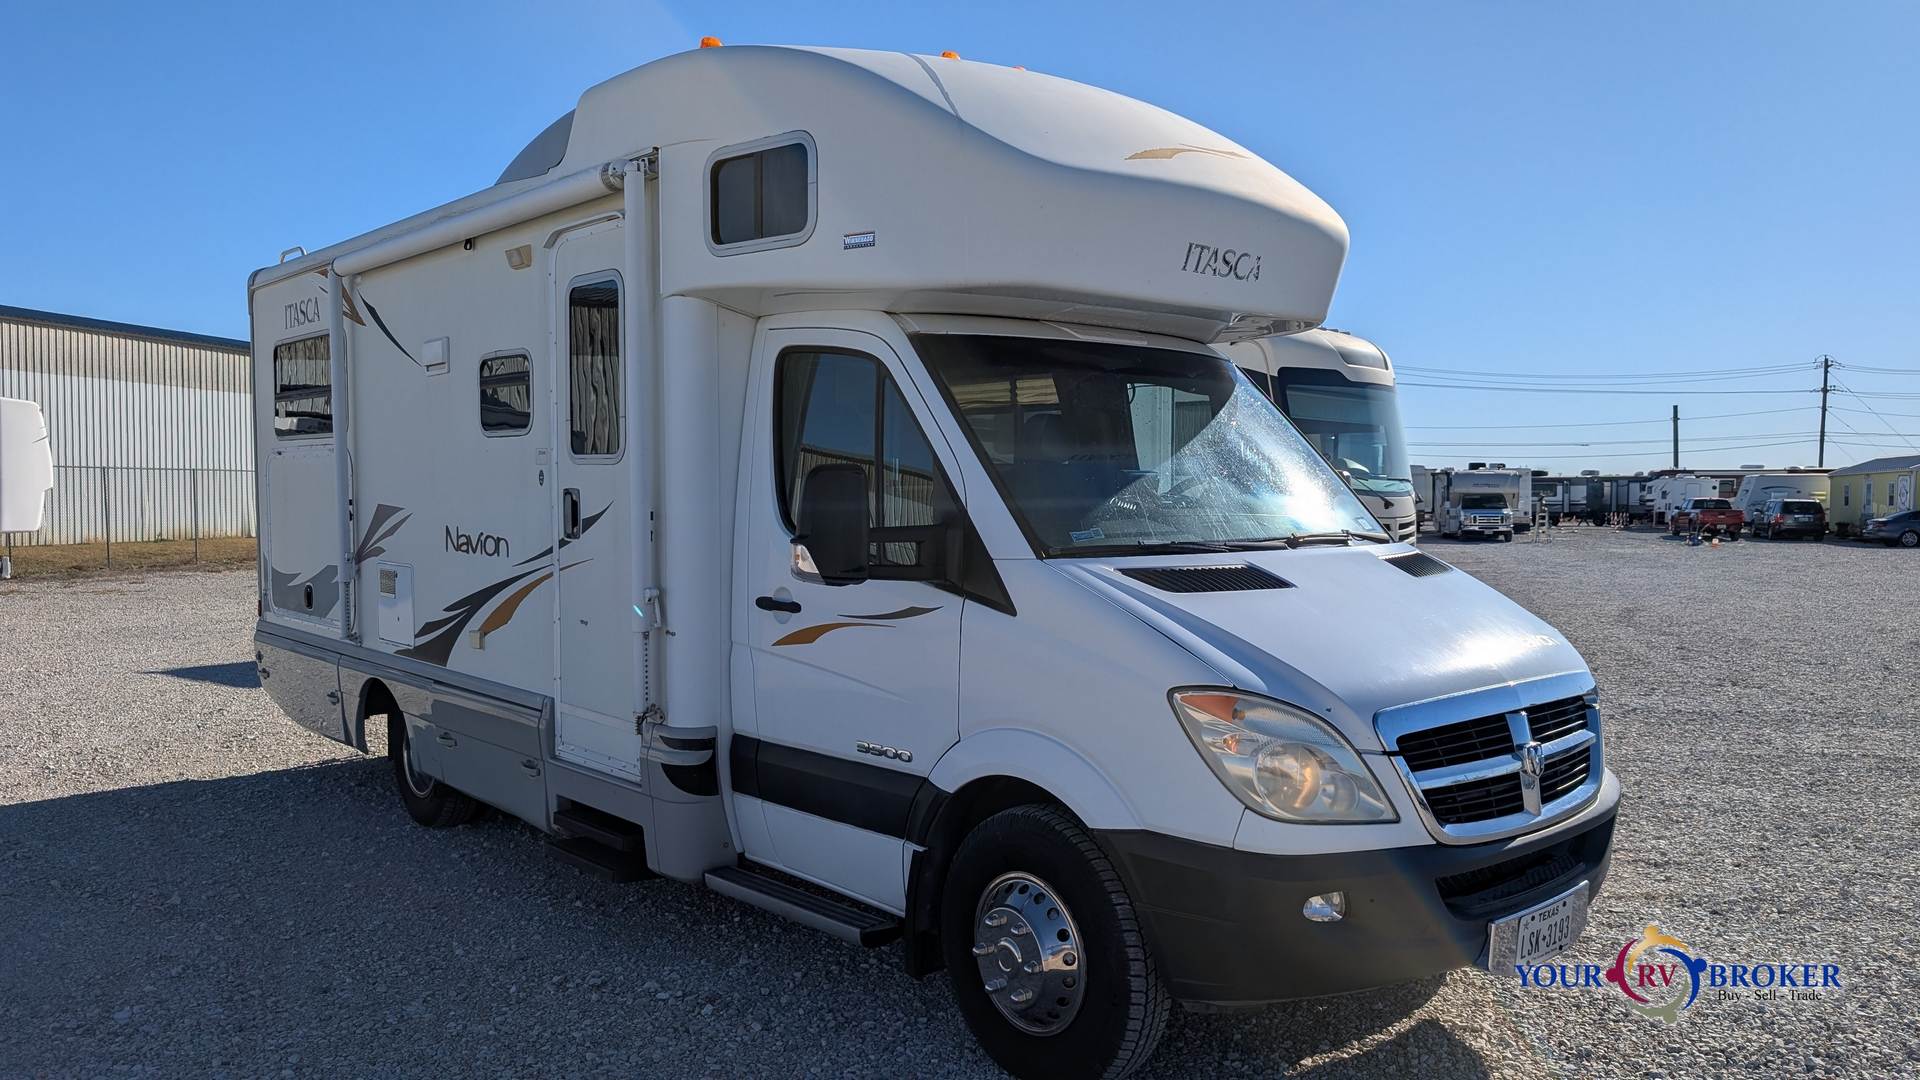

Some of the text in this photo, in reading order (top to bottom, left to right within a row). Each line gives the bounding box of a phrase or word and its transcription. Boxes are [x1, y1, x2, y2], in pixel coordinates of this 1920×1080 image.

[1181, 242, 1261, 282] ITASCA
[284, 296, 320, 330] ITASCA
[445, 524, 509, 558] Navion
[856, 740, 913, 763] 3500
[1538, 905, 1560, 923] TEXAS
